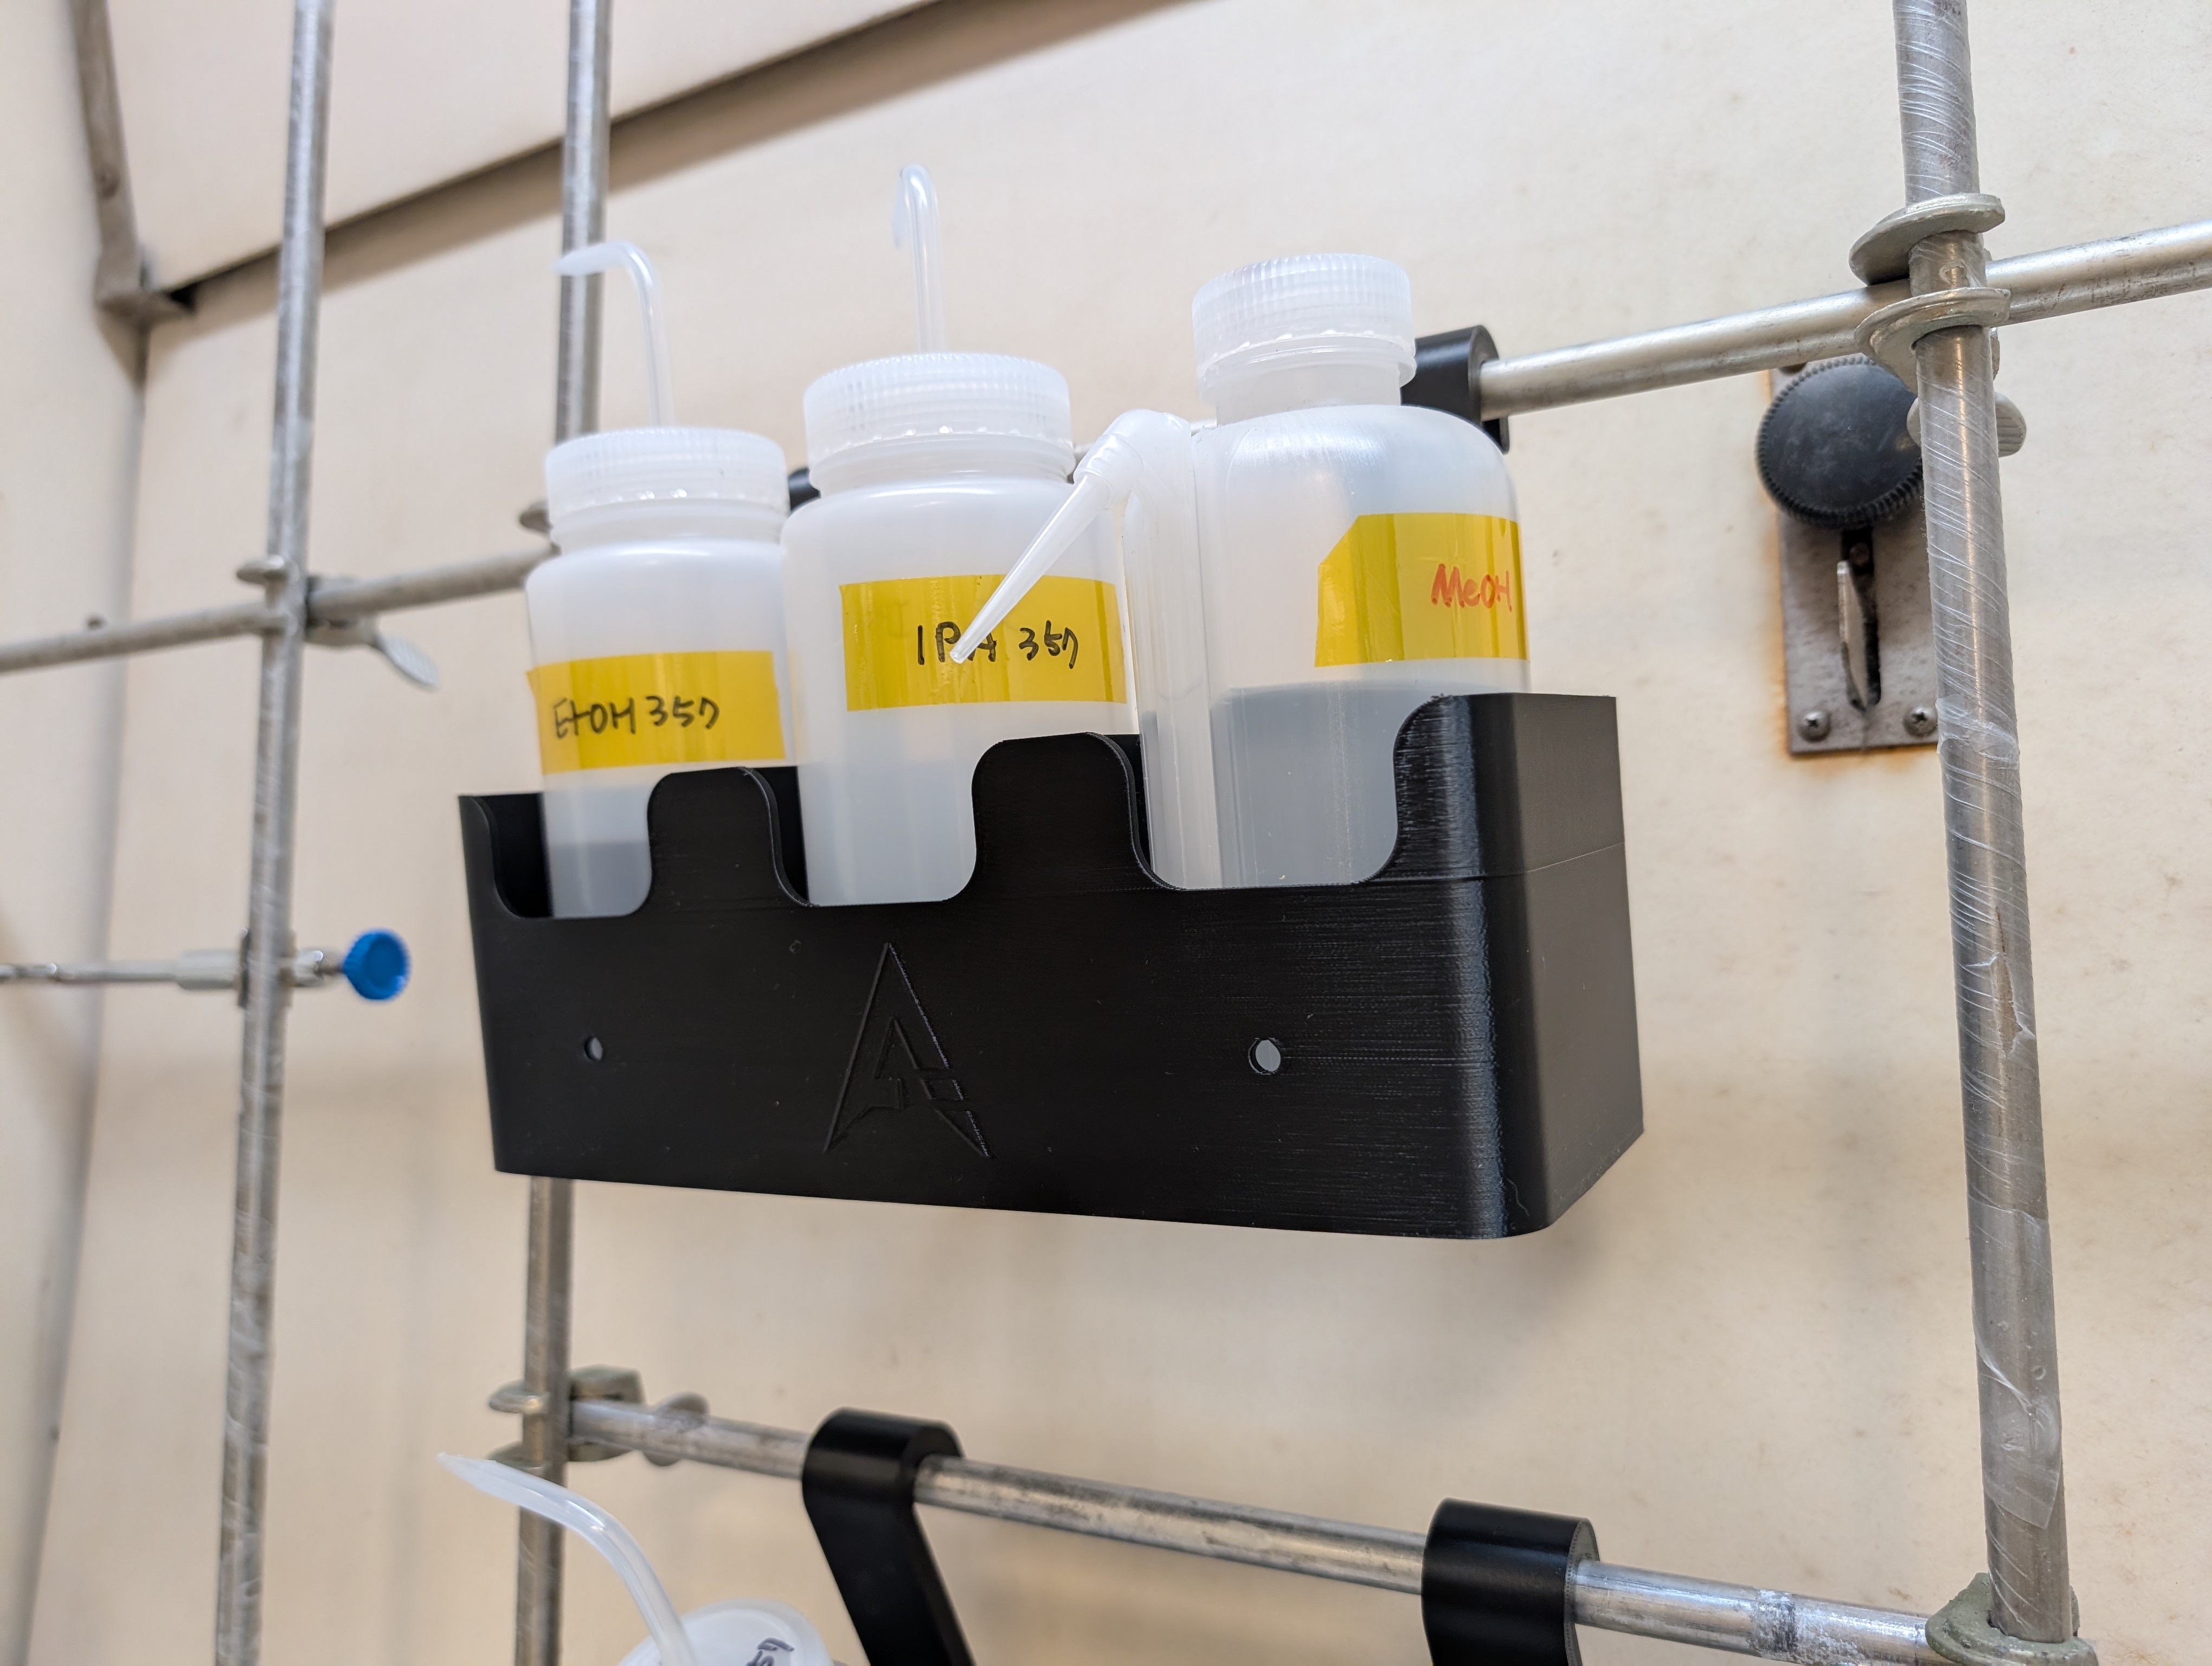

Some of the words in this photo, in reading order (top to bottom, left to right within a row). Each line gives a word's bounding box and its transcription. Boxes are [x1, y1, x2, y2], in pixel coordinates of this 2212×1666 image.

[1430, 563, 1513, 612] MeOH
[1018, 619, 1079, 669] 357
[552, 696, 636, 739] EtOH
[646, 695, 721, 730] 357
